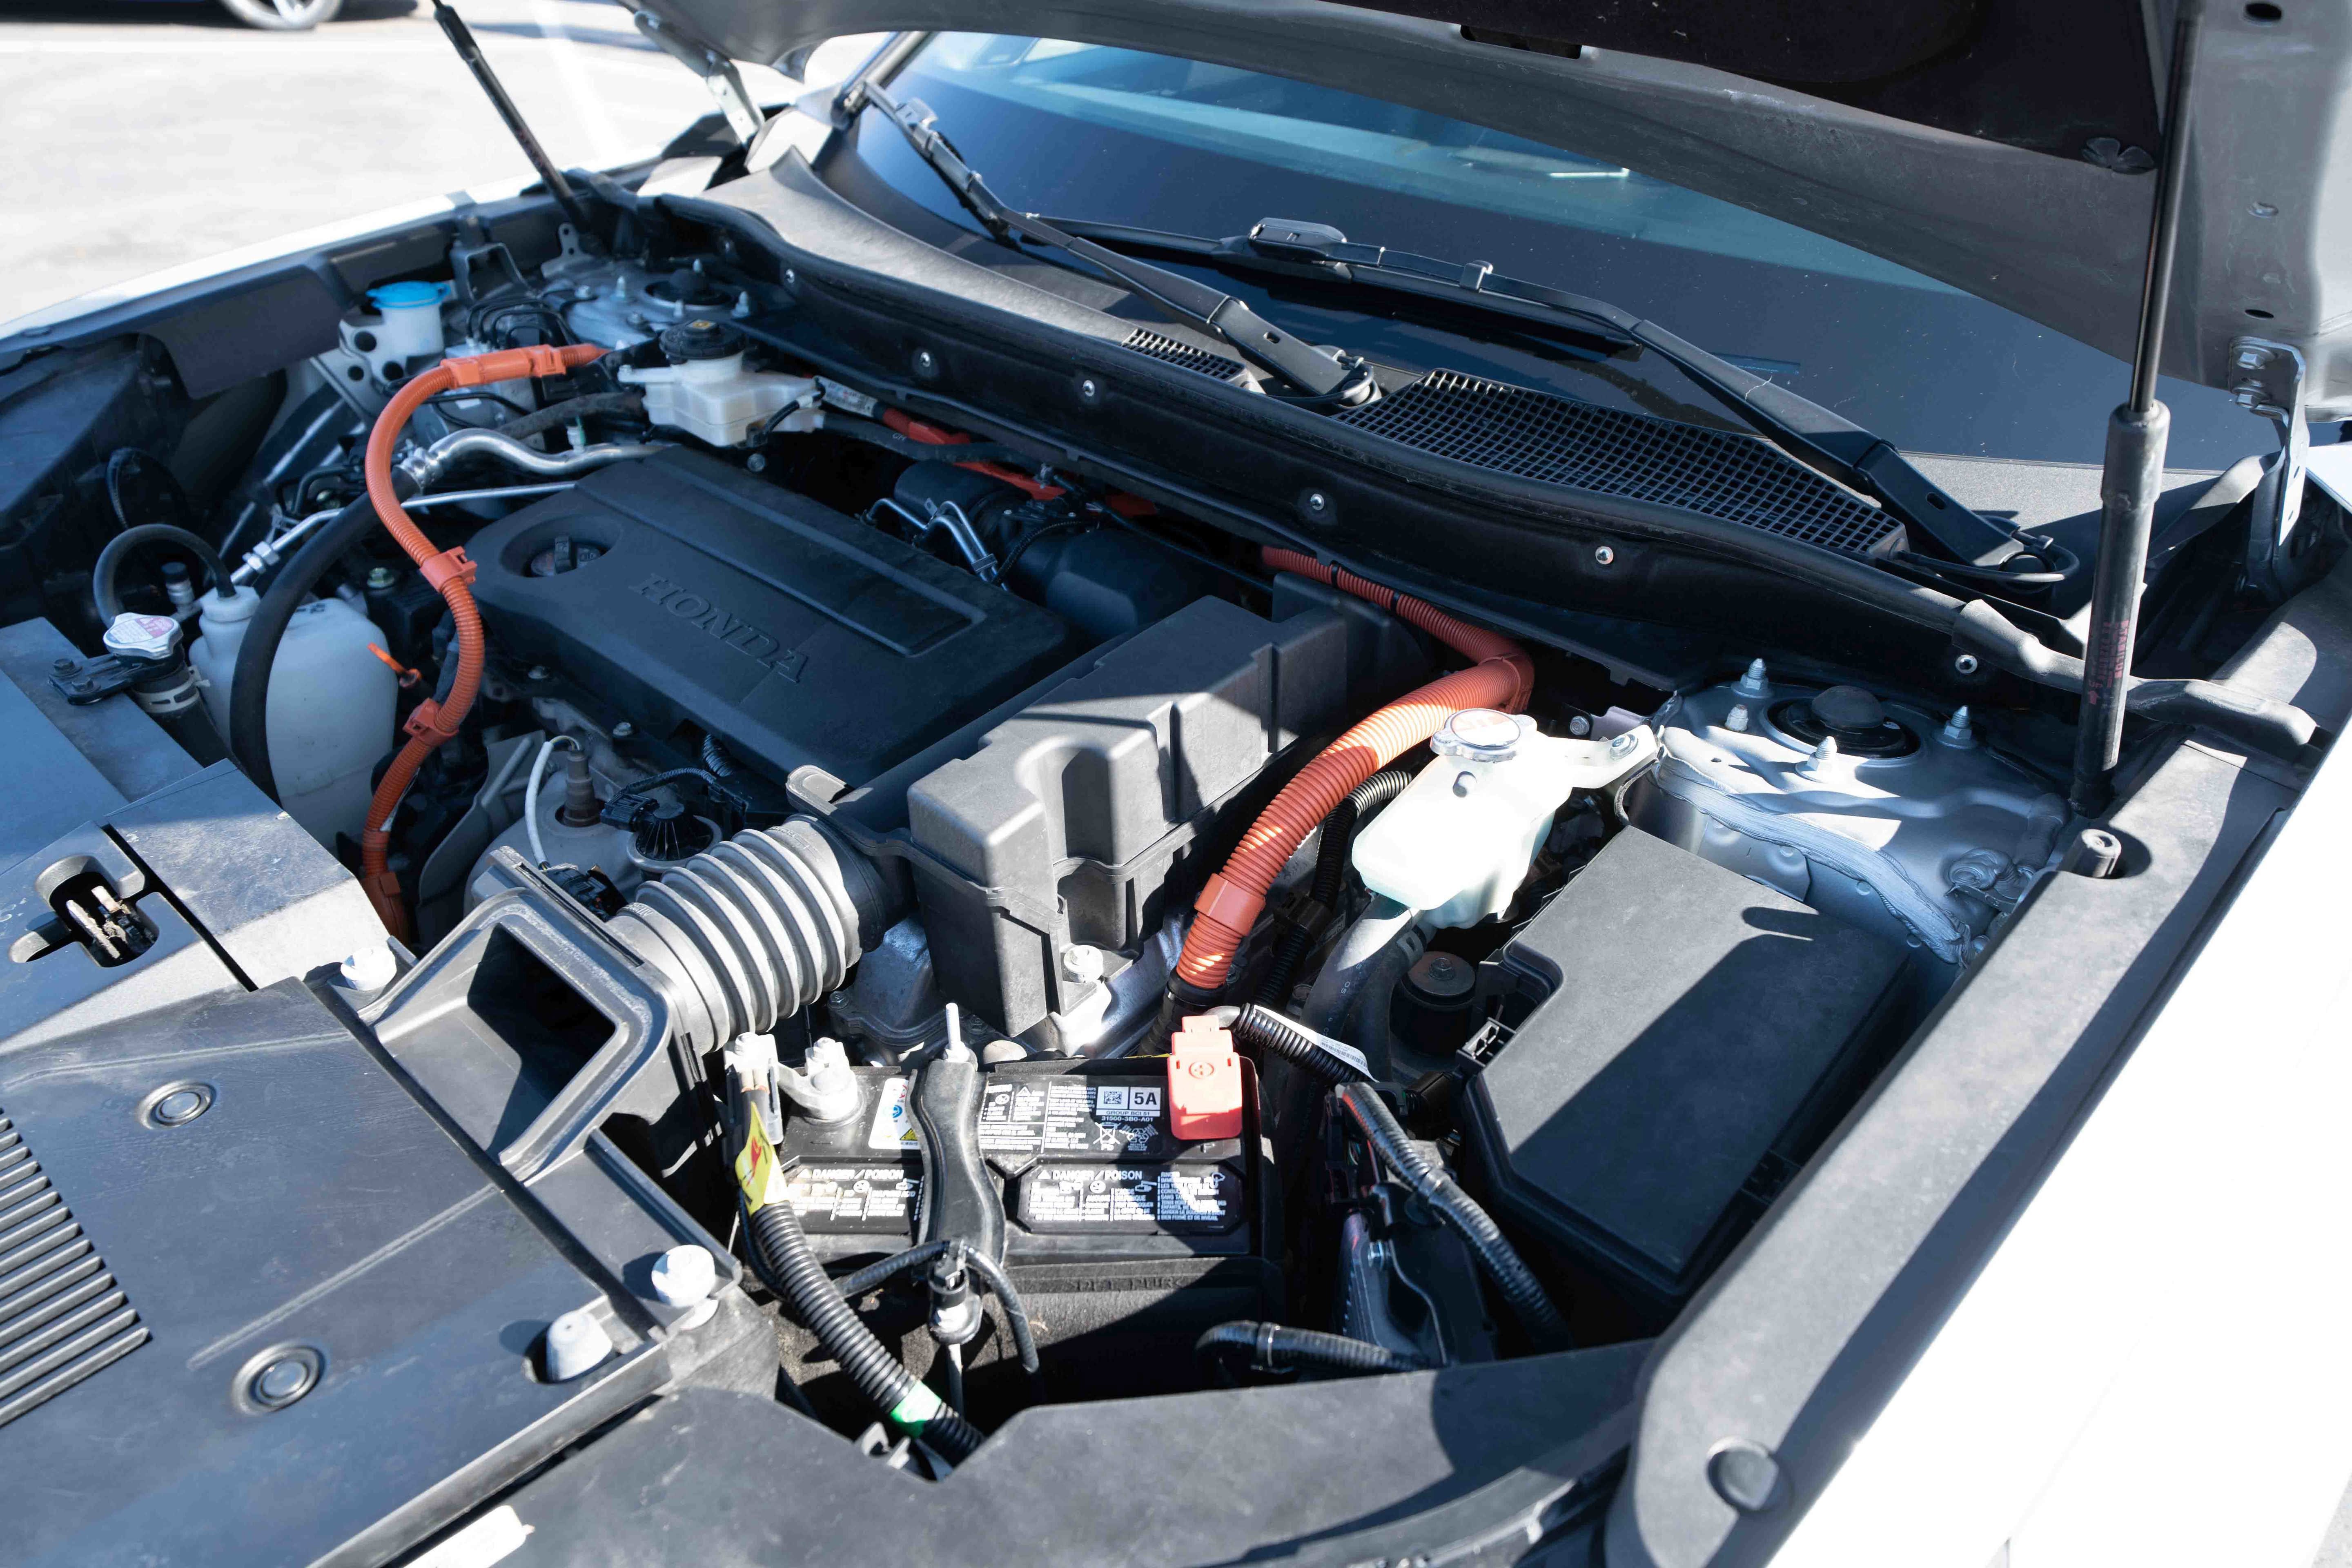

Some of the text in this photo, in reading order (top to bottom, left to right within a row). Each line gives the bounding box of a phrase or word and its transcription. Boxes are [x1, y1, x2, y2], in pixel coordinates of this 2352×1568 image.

[628, 573, 809, 684] HONDA
[1134, 1092, 1157, 1105] 5A
[812, 1169, 855, 1179] DANGER
[864, 1169, 904, 1179] POISON
[1052, 1170, 1094, 1180] DANGER
[1105, 1169, 1143, 1180] POISON
